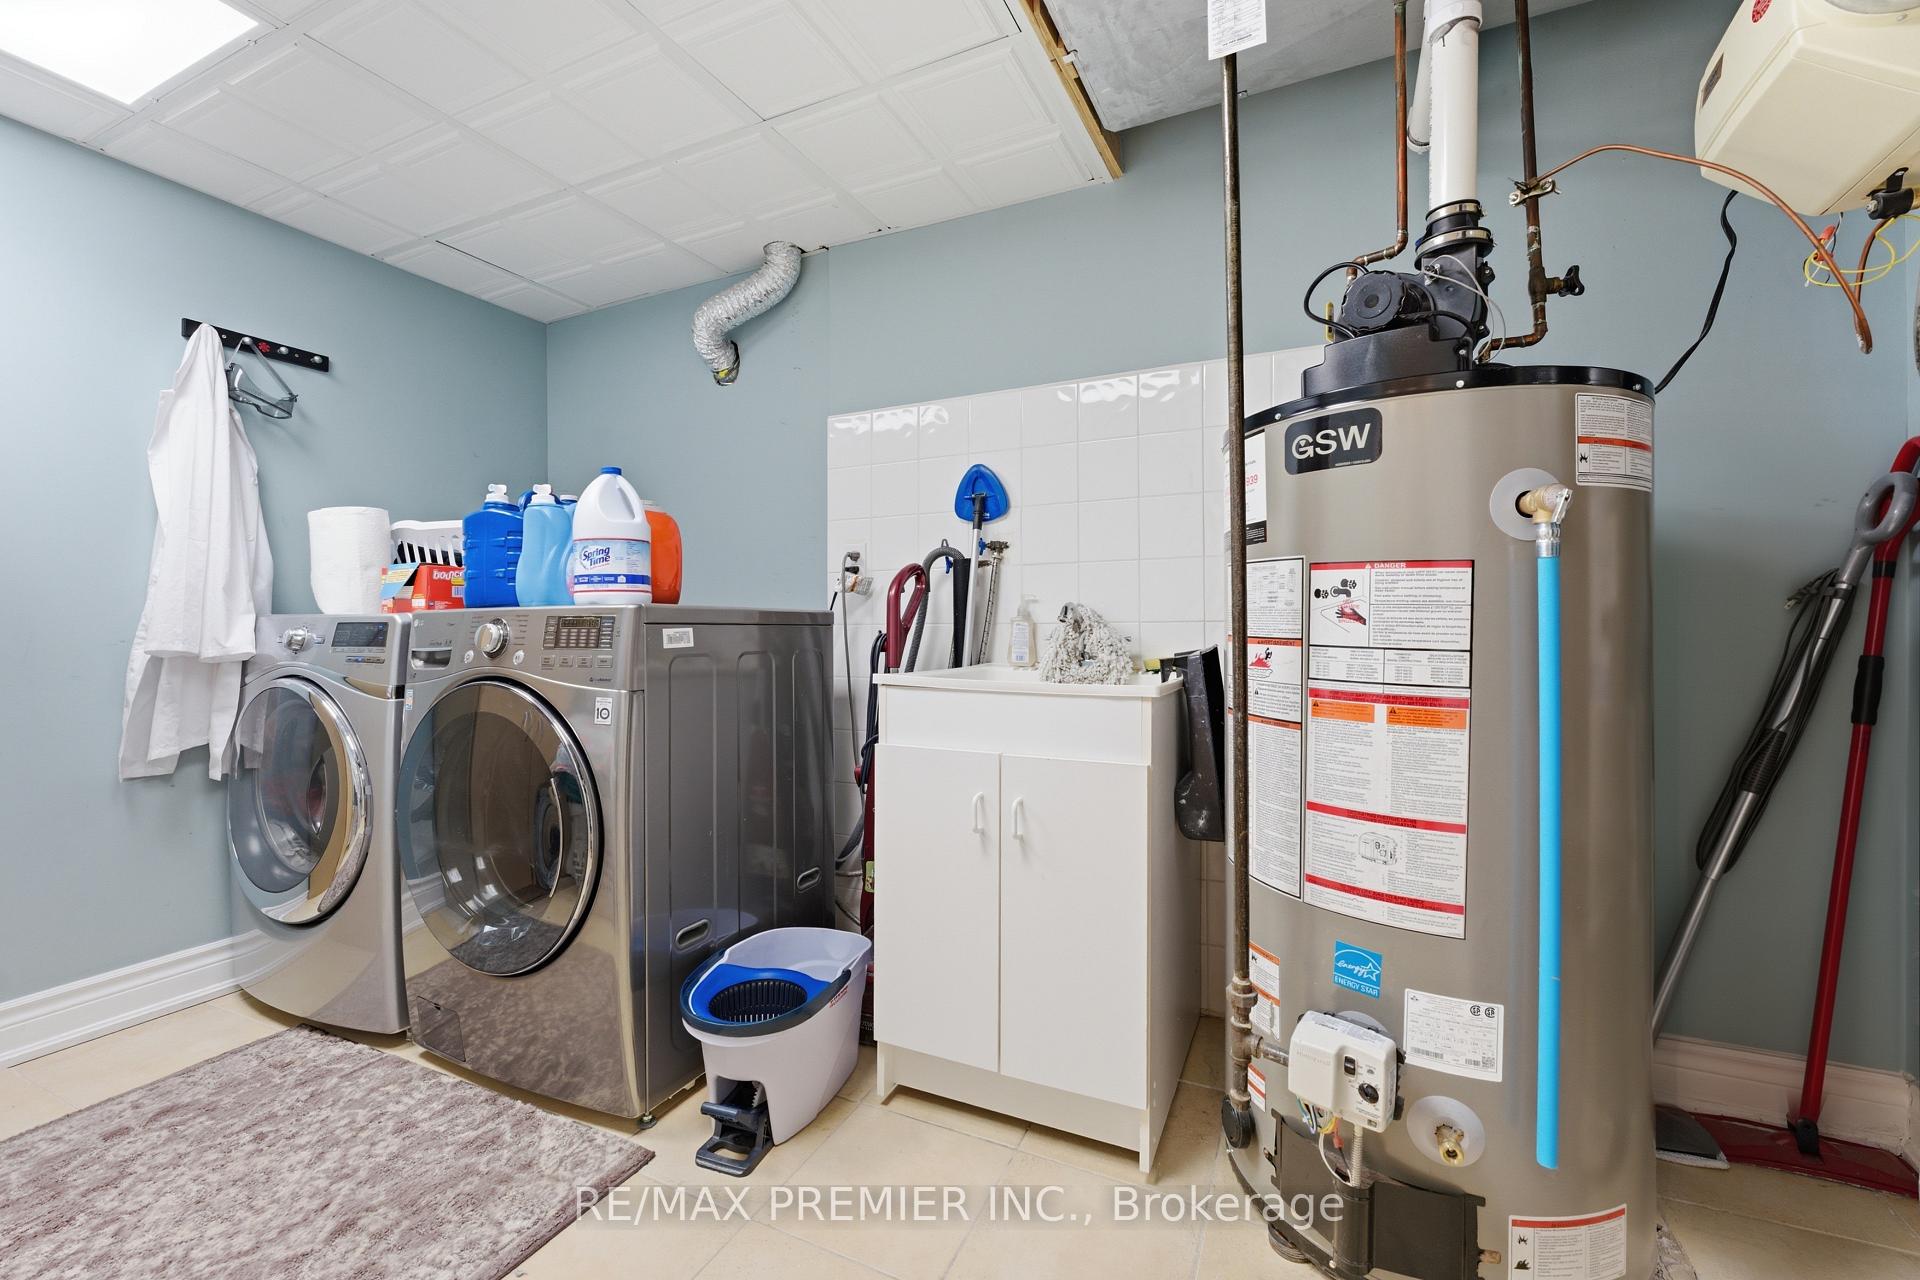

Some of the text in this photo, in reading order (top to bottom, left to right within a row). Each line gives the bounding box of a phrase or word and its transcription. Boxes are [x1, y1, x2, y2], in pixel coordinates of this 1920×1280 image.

[1292, 423, 1371, 459] GSW
[582, 546, 610, 562] Spring
[589, 555, 610, 567] Time
[596, 707, 610, 720] 10
[1334, 975, 1379, 997] ENERGY STAR
